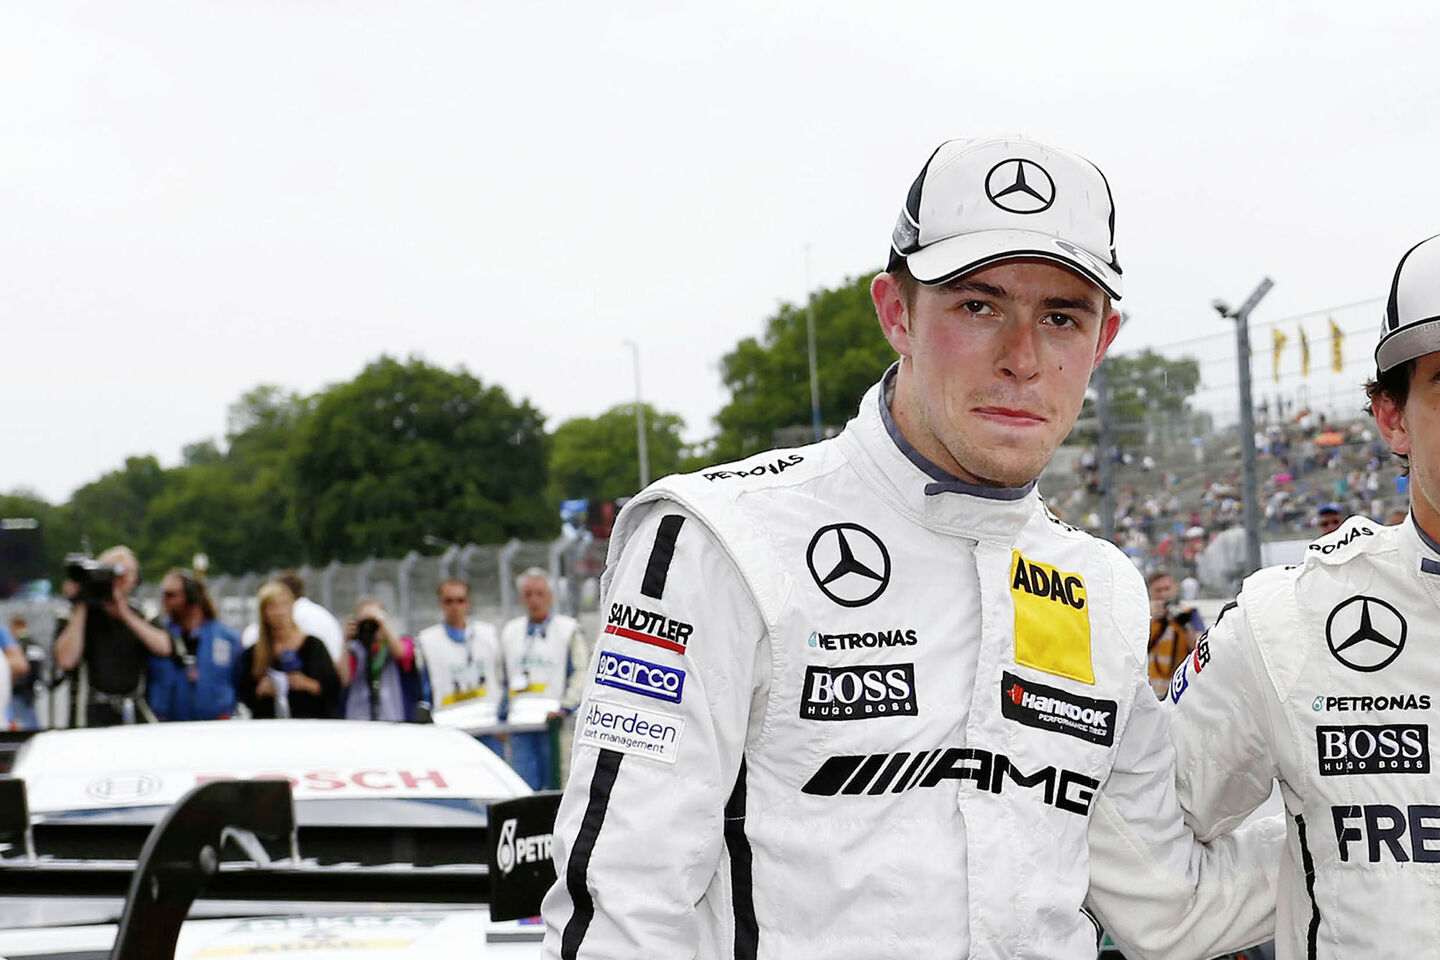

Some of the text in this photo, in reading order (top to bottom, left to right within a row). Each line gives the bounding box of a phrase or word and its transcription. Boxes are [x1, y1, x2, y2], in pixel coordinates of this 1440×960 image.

[1013, 556, 1085, 610] ADAC
[608, 602, 694, 645] SANDTLER
[599, 655, 680, 692] sparco
[808, 669, 911, 703] BOSS
[808, 702, 912, 715] HUGO BOSS
[1326, 694, 1431, 712] PETRONAS
[586, 704, 676, 743] Aberdeen
[599, 730, 665, 754] management
[1321, 729, 1423, 759] BOSS
[1324, 760, 1423, 771] HUGO BOSS
[918, 748, 1101, 816] AMG
[515, 833, 554, 864] PETR
